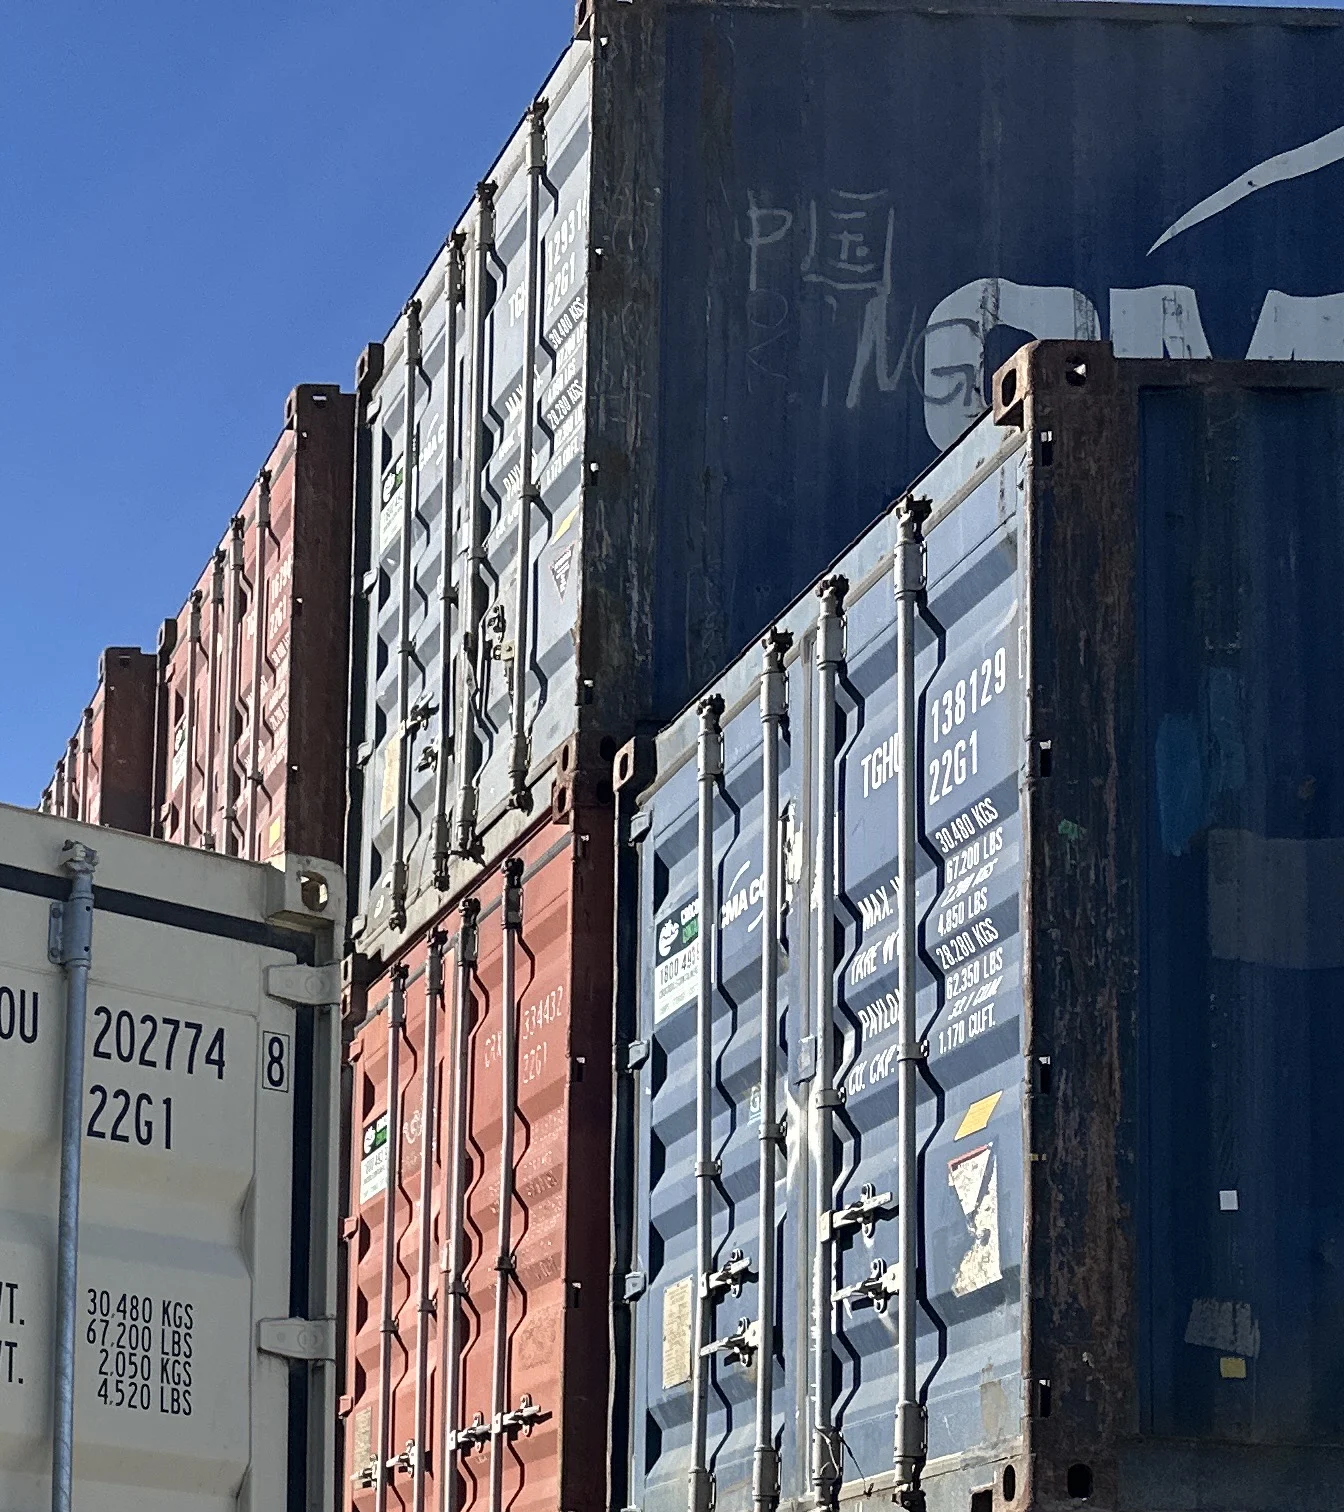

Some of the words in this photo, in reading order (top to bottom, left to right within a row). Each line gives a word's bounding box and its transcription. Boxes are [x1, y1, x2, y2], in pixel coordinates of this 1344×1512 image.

[931, 647, 1006, 743] 138129
[929, 730, 978, 806] 22G1
[970, 797, 999, 828] KGS
[984, 827, 1003, 860] LBS
[968, 887, 988, 917] LBS
[971, 917, 999, 948] KGS
[984, 947, 1003, 979] LBS
[92, 1005, 226, 1080] 202774
[267, 1036, 285, 1088] 8
[86, 1083, 173, 1149] 22G1
[162, 1300, 193, 1331] KGS
[161, 1328, 193, 1359] LBS
[161, 1357, 192, 1387] KGS
[160, 1385, 192, 1416] LBS
